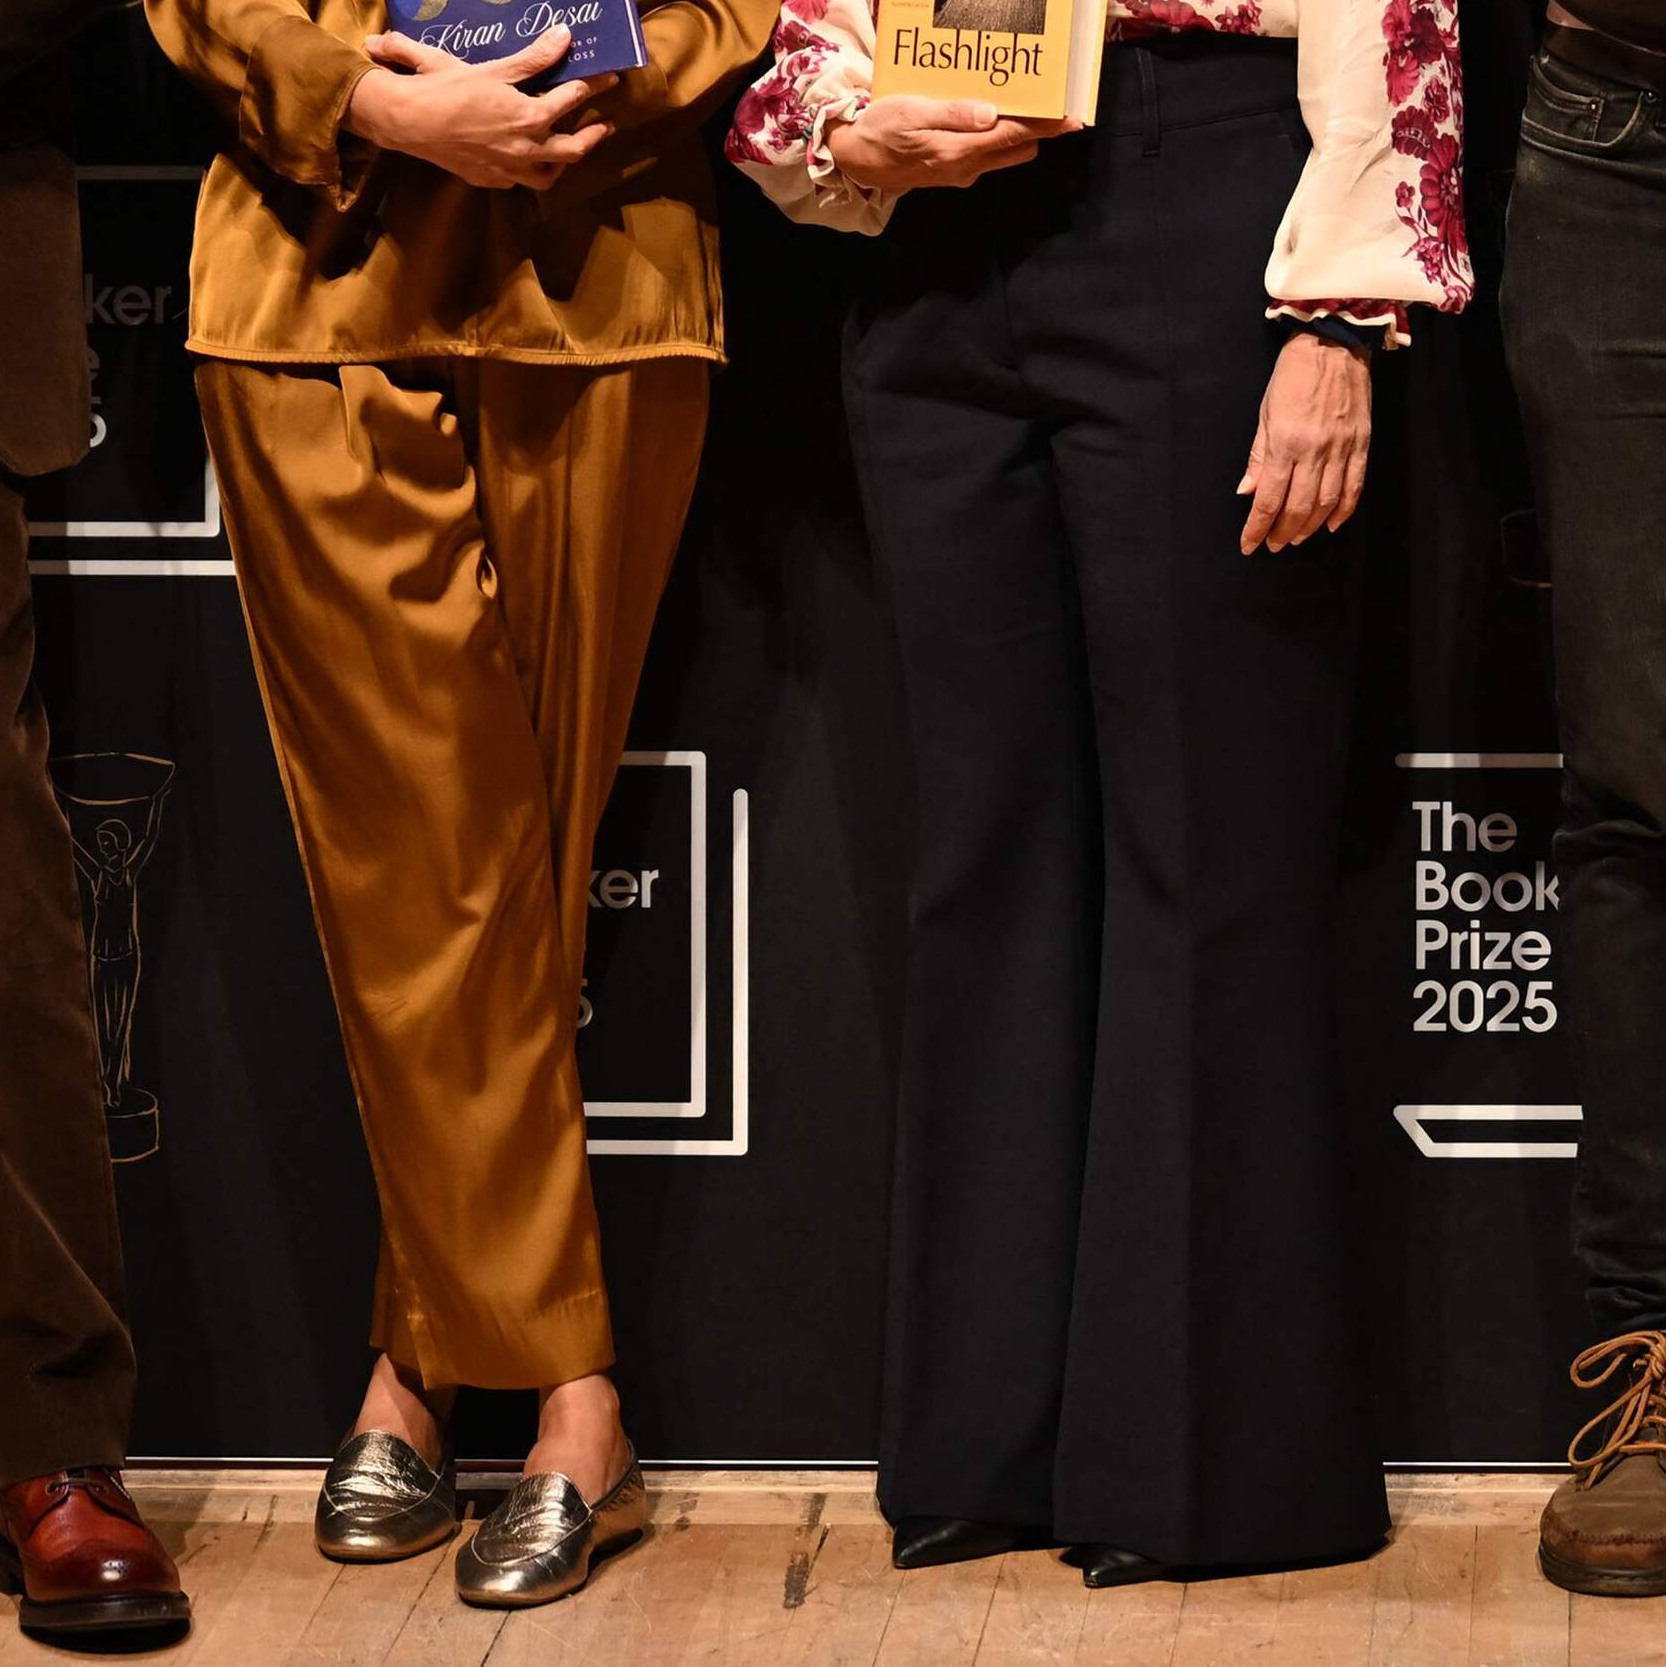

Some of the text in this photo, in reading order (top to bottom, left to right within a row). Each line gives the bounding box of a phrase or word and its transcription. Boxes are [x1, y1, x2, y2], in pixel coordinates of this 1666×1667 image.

[421, 20, 506, 59] Kiran
[893, 27, 1043, 86] Flashlight
[85, 273, 173, 326] ker
[1413, 801, 1518, 852] The
[1416, 861, 1560, 911] Book
[1416, 920, 1552, 971] Prize
[1413, 980, 1558, 1033] 2025
